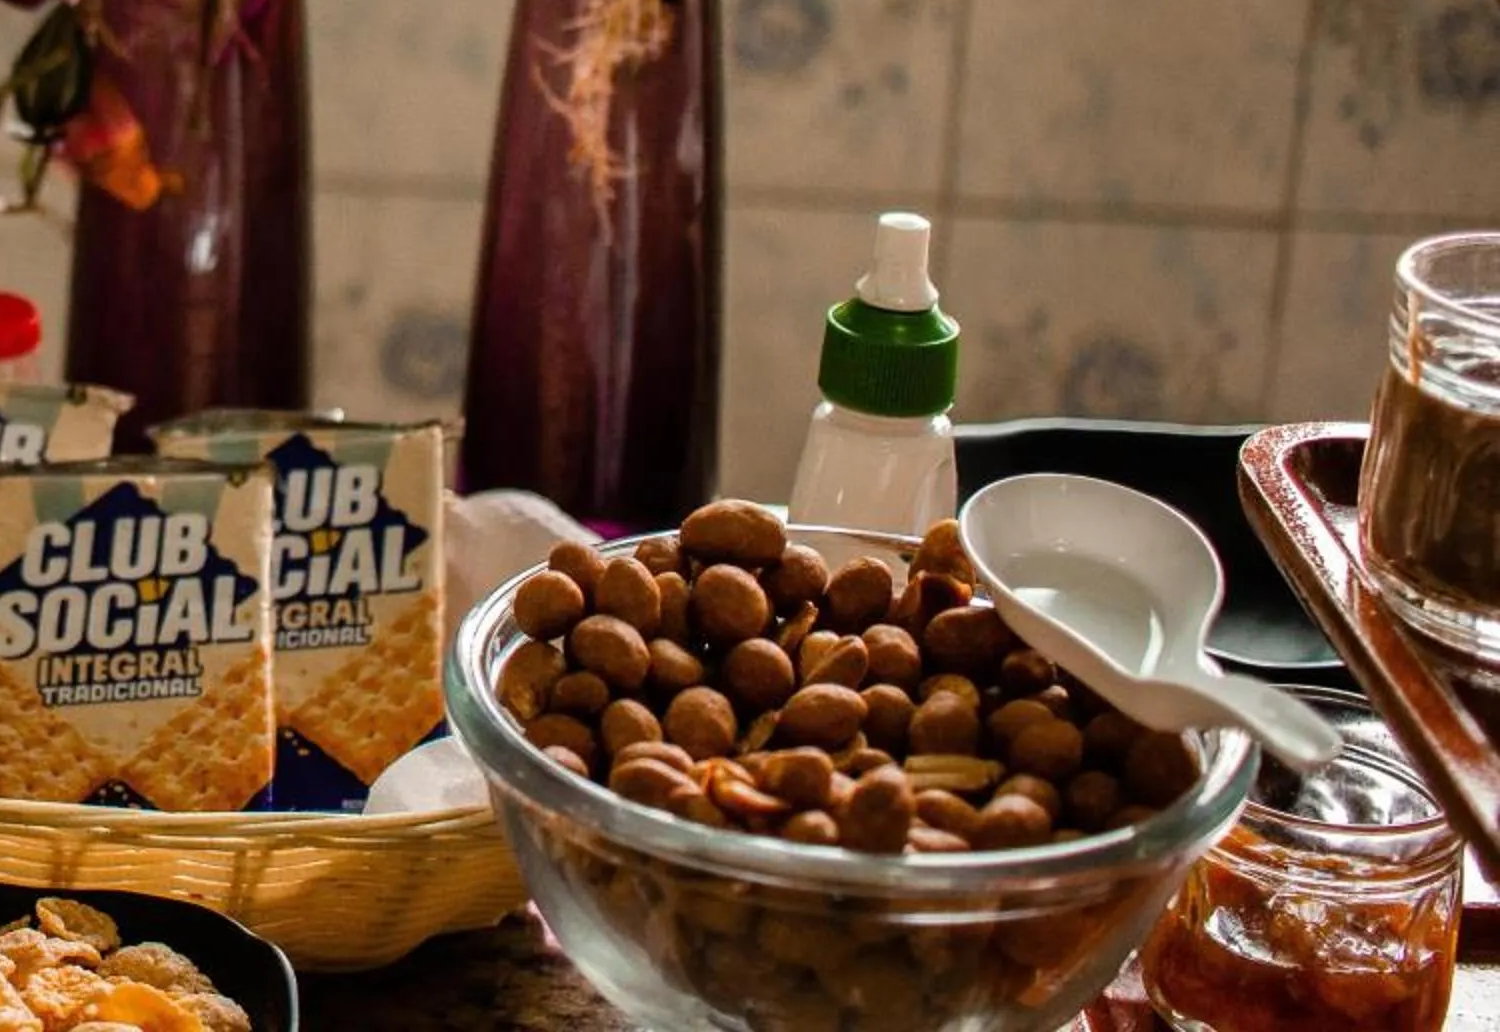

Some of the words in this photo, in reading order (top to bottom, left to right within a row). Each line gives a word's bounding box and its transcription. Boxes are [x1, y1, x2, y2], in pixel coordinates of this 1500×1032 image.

[273, 464, 379, 532] UB
[20, 512, 208, 588] CLUB
[274, 598, 372, 630] GRAL
[277, 625, 370, 649] ICIONAL
[38, 647, 202, 686] INTEGRAL
[40, 677, 202, 706] TRADICIONAL
